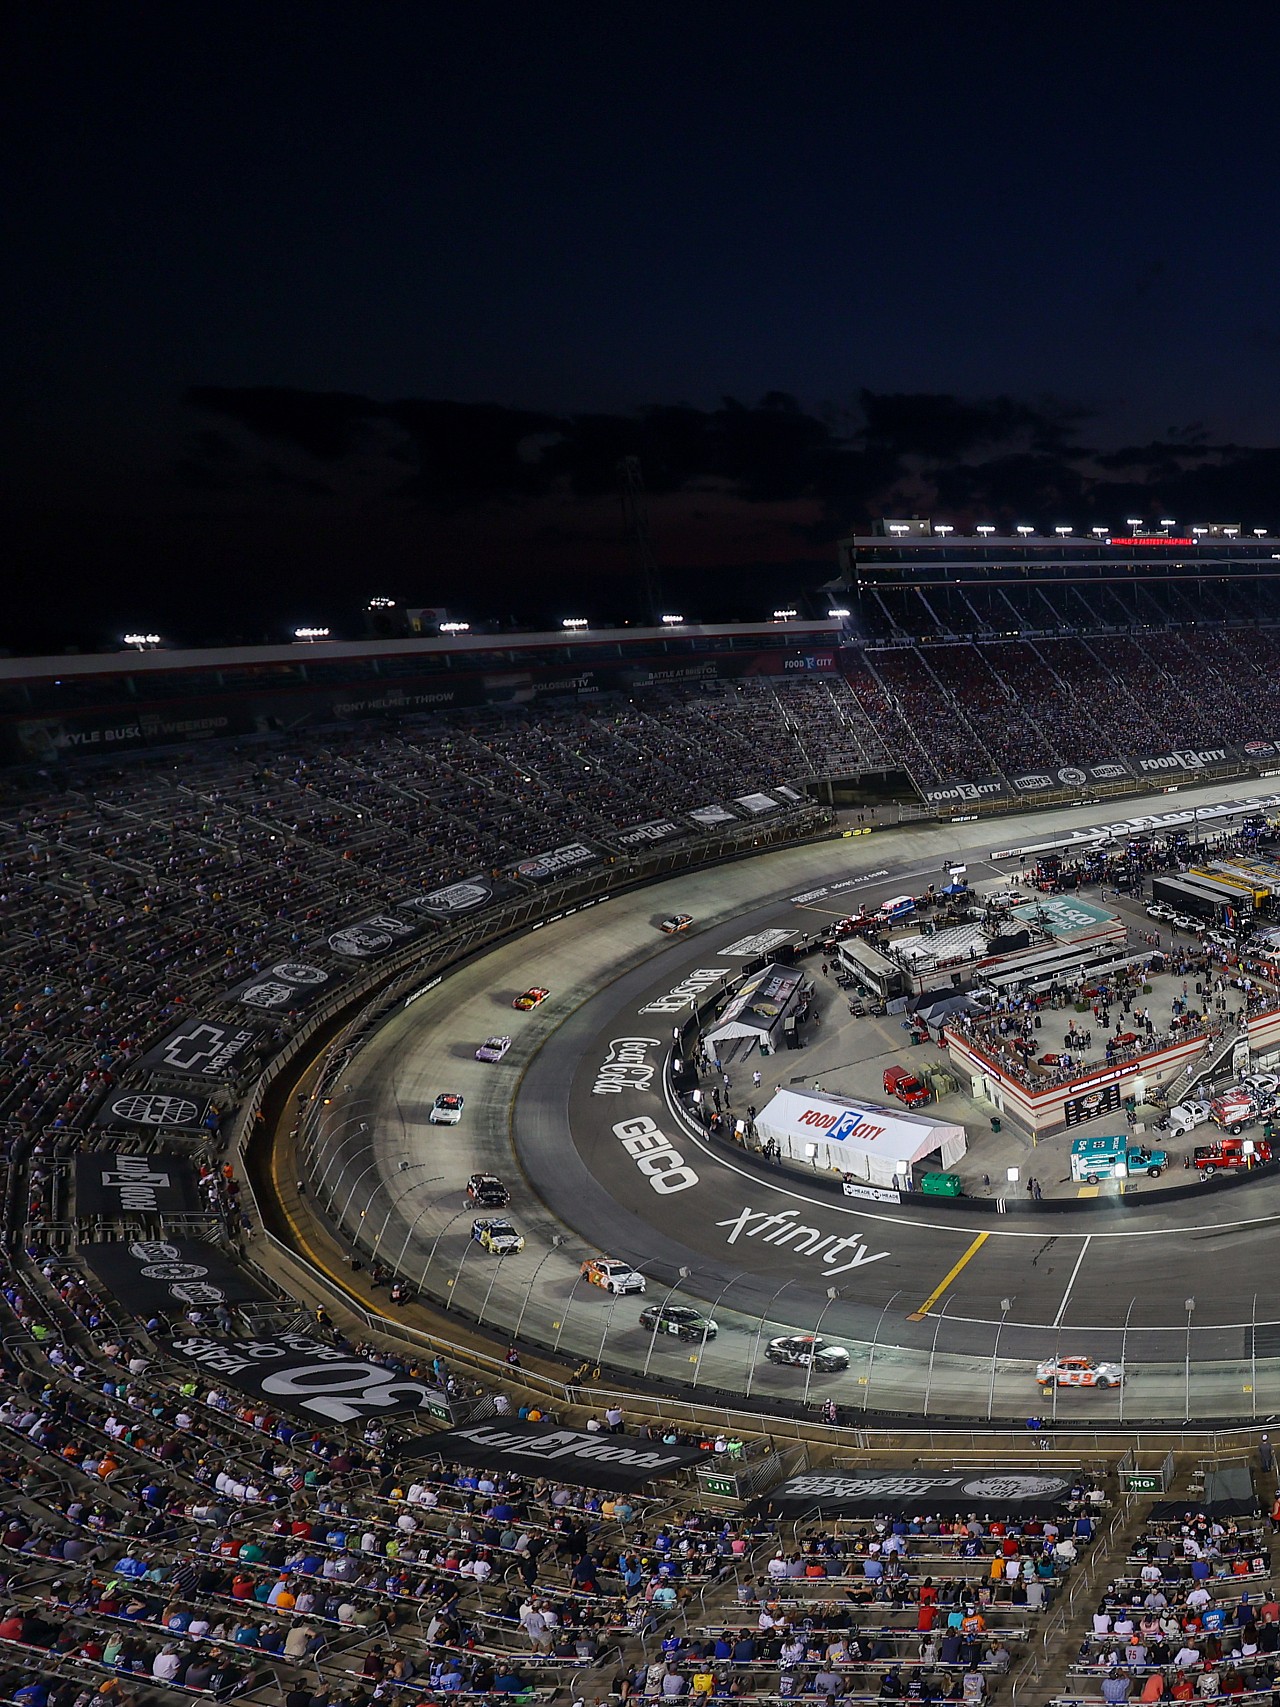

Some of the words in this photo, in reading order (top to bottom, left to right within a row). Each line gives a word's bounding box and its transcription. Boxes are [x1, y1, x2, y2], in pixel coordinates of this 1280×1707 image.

[648, 670, 675, 680] BATTLE
[675, 669, 684, 677] AT
[685, 666, 718, 676] BRISTOL
[784, 659, 804, 669] FOOD
[816, 658, 833, 667] CITY
[532, 680, 577, 691] COLOSSUS
[578, 679, 589, 688] TV
[367, 695, 411, 710] HELMET
[414, 692, 455, 705] THROW
[60, 730, 101, 747] KYLE
[161, 717, 229, 734] WEEKEND
[1139, 757, 1179, 771] FOOD
[1198, 749, 1227, 762] CITY
[1093, 765, 1127, 777] BUSH'S
[927, 789, 958, 801] FOOD
[977, 783, 1002, 794] CITY
[1016, 776, 1052, 788] BUSH'S
[1162, 804, 1229, 821] FOOD
[618, 831, 646, 843] FOOD
[656, 823, 677, 833] CITY
[1070, 822, 1128, 838] CITY
[538, 845, 592, 868] Bristol
[638, 967, 731, 1015] BUSCH
[202, 1030, 254, 1076] CHEVROLET
[798, 1109, 833, 1129] FOOD
[851, 1121, 886, 1141] CITY
[611, 1115, 699, 1195] GEICO
[119, 1186, 158, 1211] FOOD
[716, 1205, 891, 1276] xfinity
[172, 1337, 261, 1376] YEARS
[233, 1340, 286, 1359] OF
[448, 1427, 530, 1450] CITY
[576, 1448, 681, 1468] FOOD
[785, 1484, 935, 1498] TRACKER
[1134, 1480, 1150, 1488] HG
